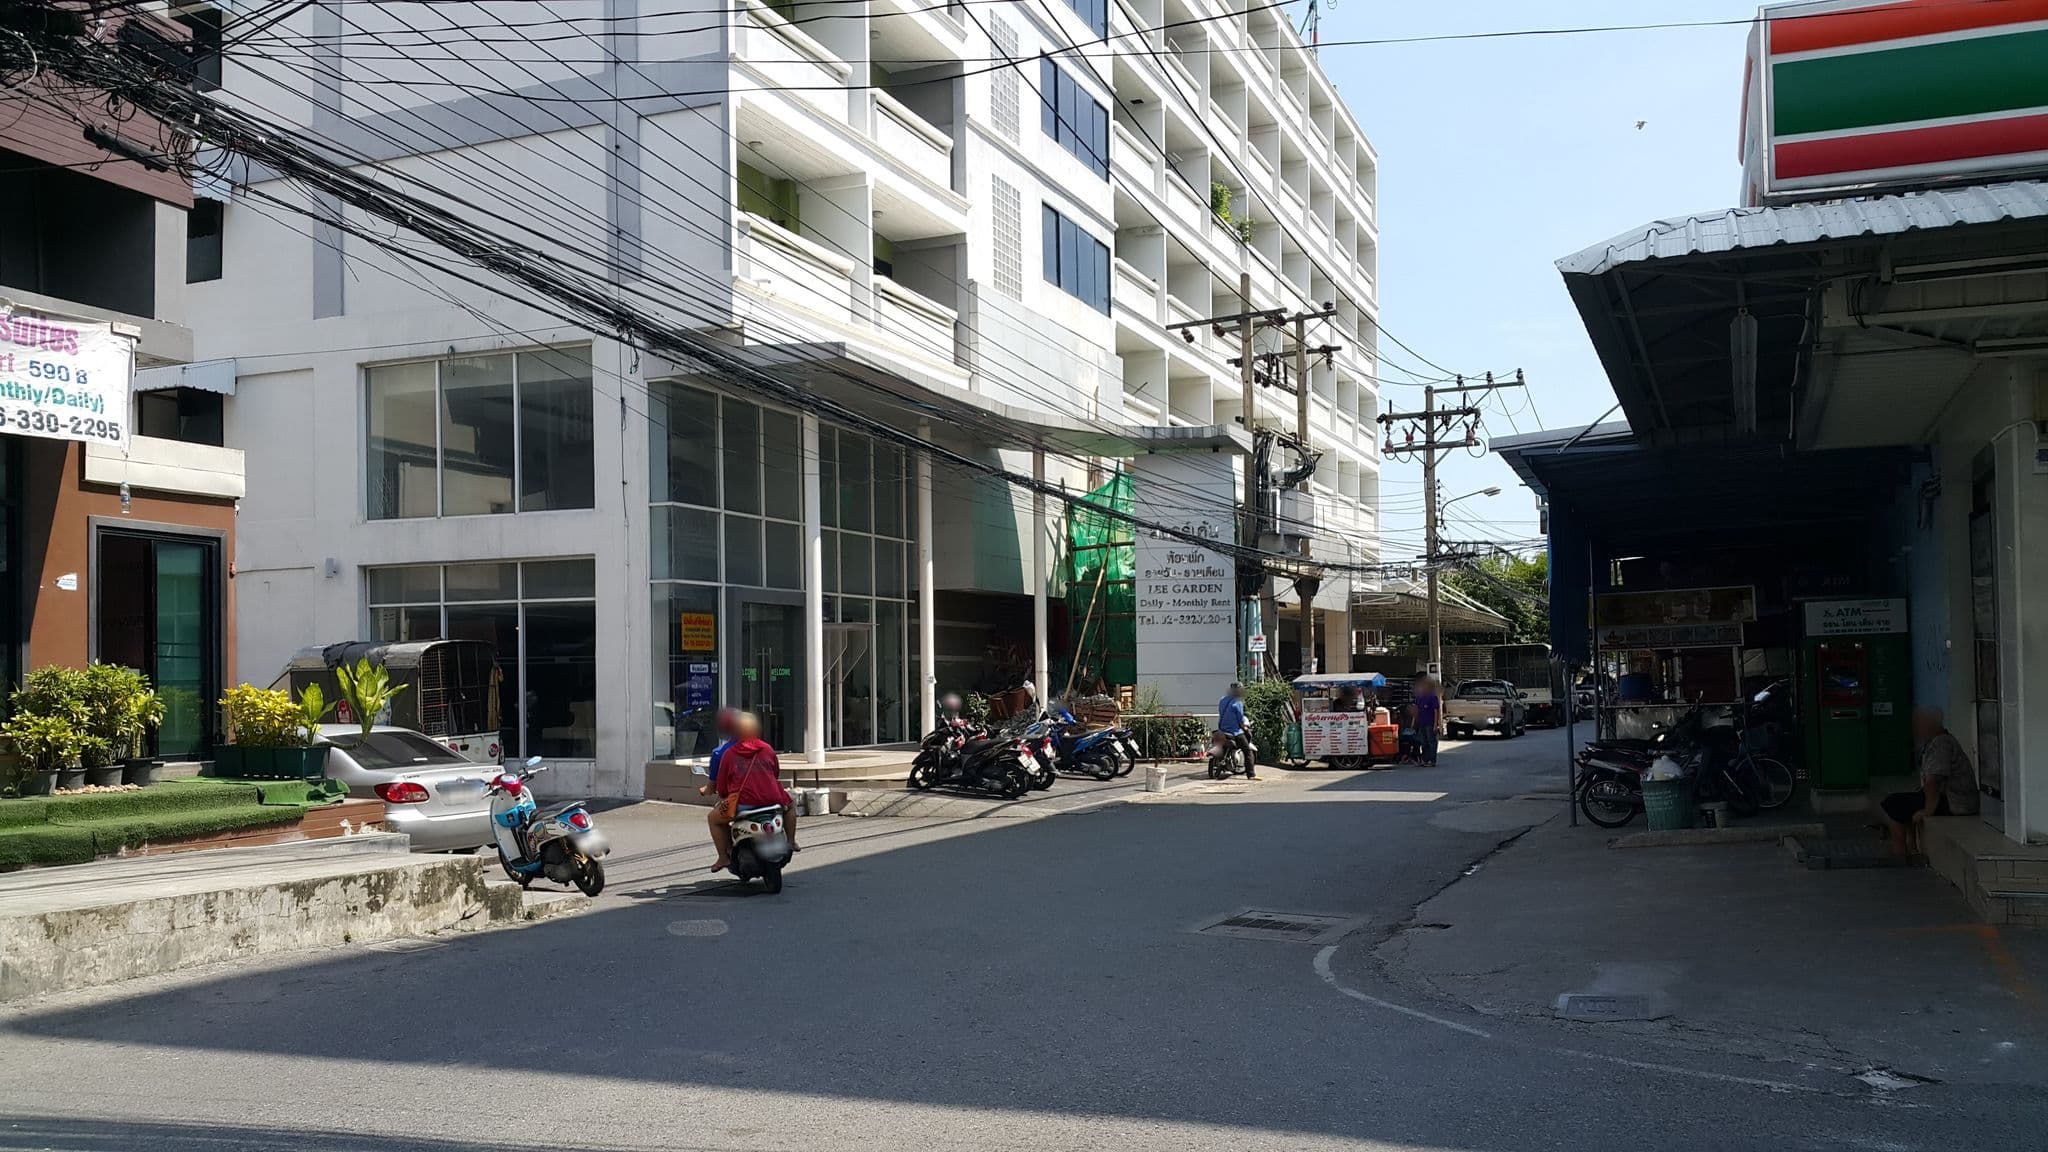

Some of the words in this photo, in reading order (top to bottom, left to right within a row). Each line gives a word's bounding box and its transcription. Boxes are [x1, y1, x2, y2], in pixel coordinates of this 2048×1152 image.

[29, 360, 70, 382] 590
[1148, 584, 1169, 594] LEE
[1172, 583, 1223, 594] GARDEN
[1172, 599, 1208, 608] Monthly
[1211, 598, 1231, 607] Rent
